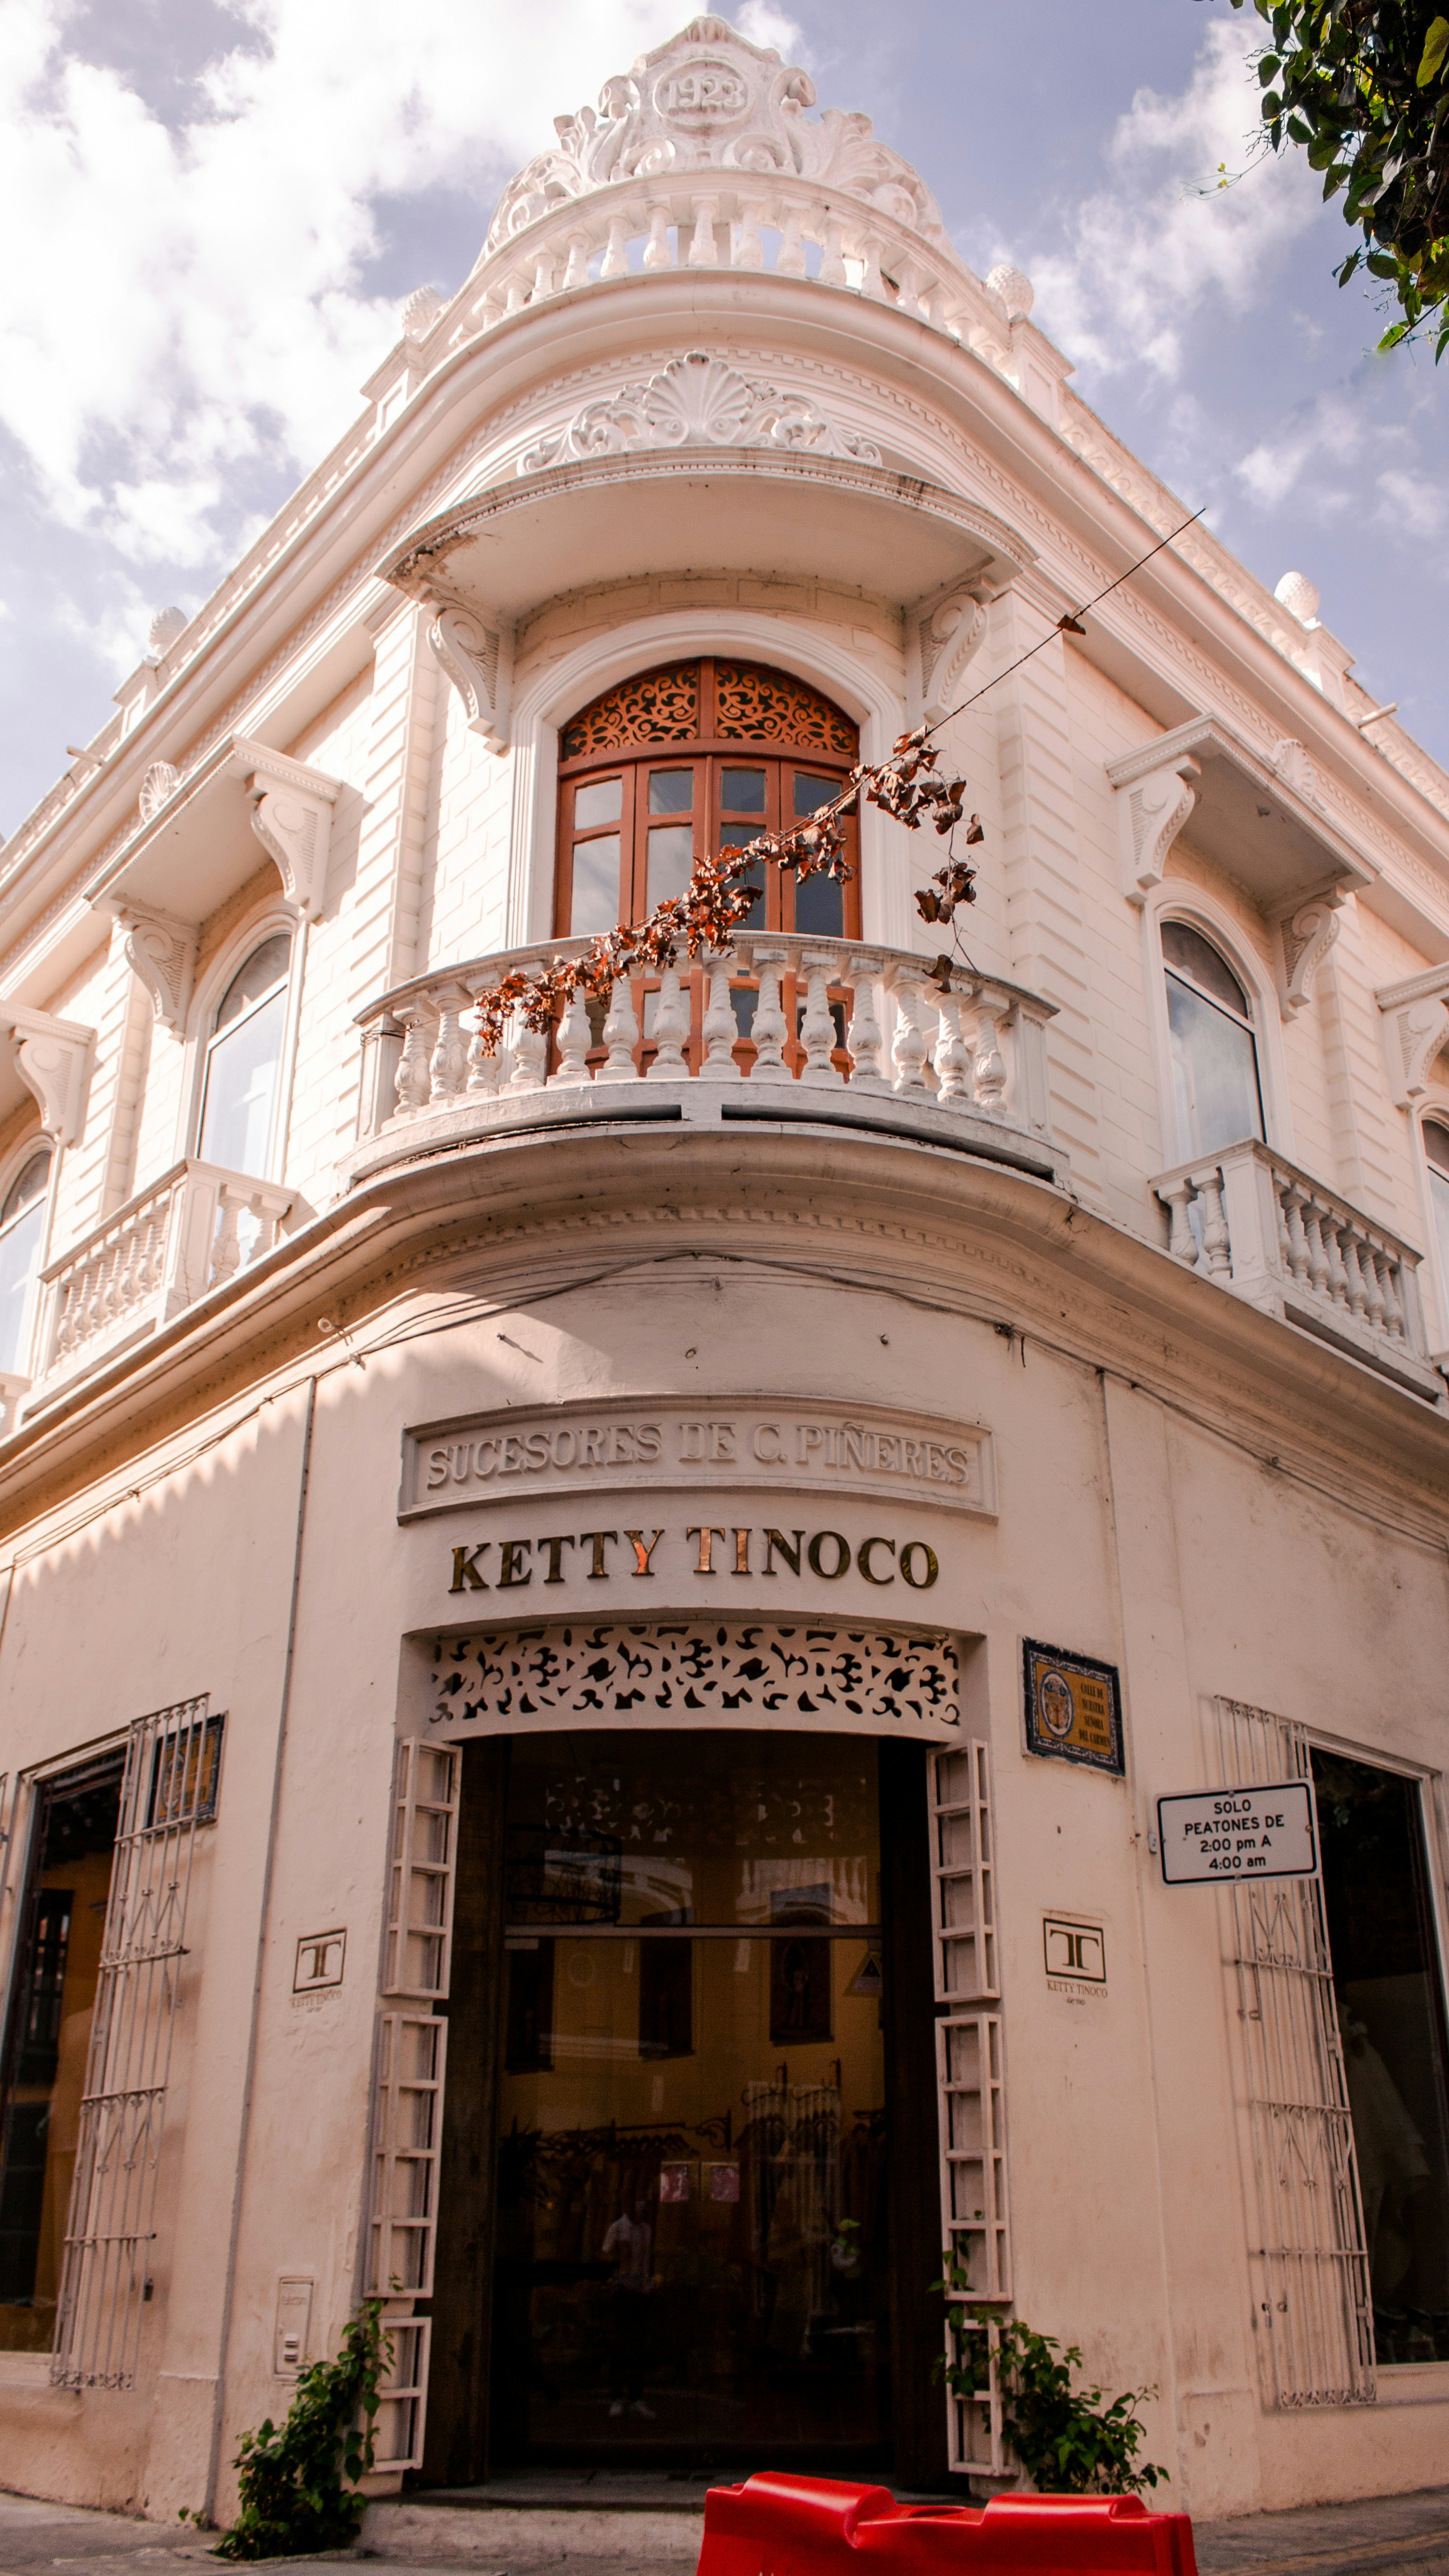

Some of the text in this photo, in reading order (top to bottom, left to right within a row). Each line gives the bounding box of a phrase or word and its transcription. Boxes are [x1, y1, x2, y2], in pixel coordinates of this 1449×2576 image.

[667, 76, 748, 116] 1923
[427, 1421, 970, 1490] SUCESORES DE C. PIÑERES
[448, 1527, 939, 1593] KETTY TINOCO
[1081, 1683, 1104, 1699] CALLE DE
[1214, 1799, 1251, 1814] SOLO
[1184, 1814, 1285, 1835] PEATONES DE
[1200, 1834, 1272, 1853] 2:00 pm A
[1209, 1855, 1267, 1870] 4:00 am
[1047, 1979, 1108, 1998] KETTY TINOCO
